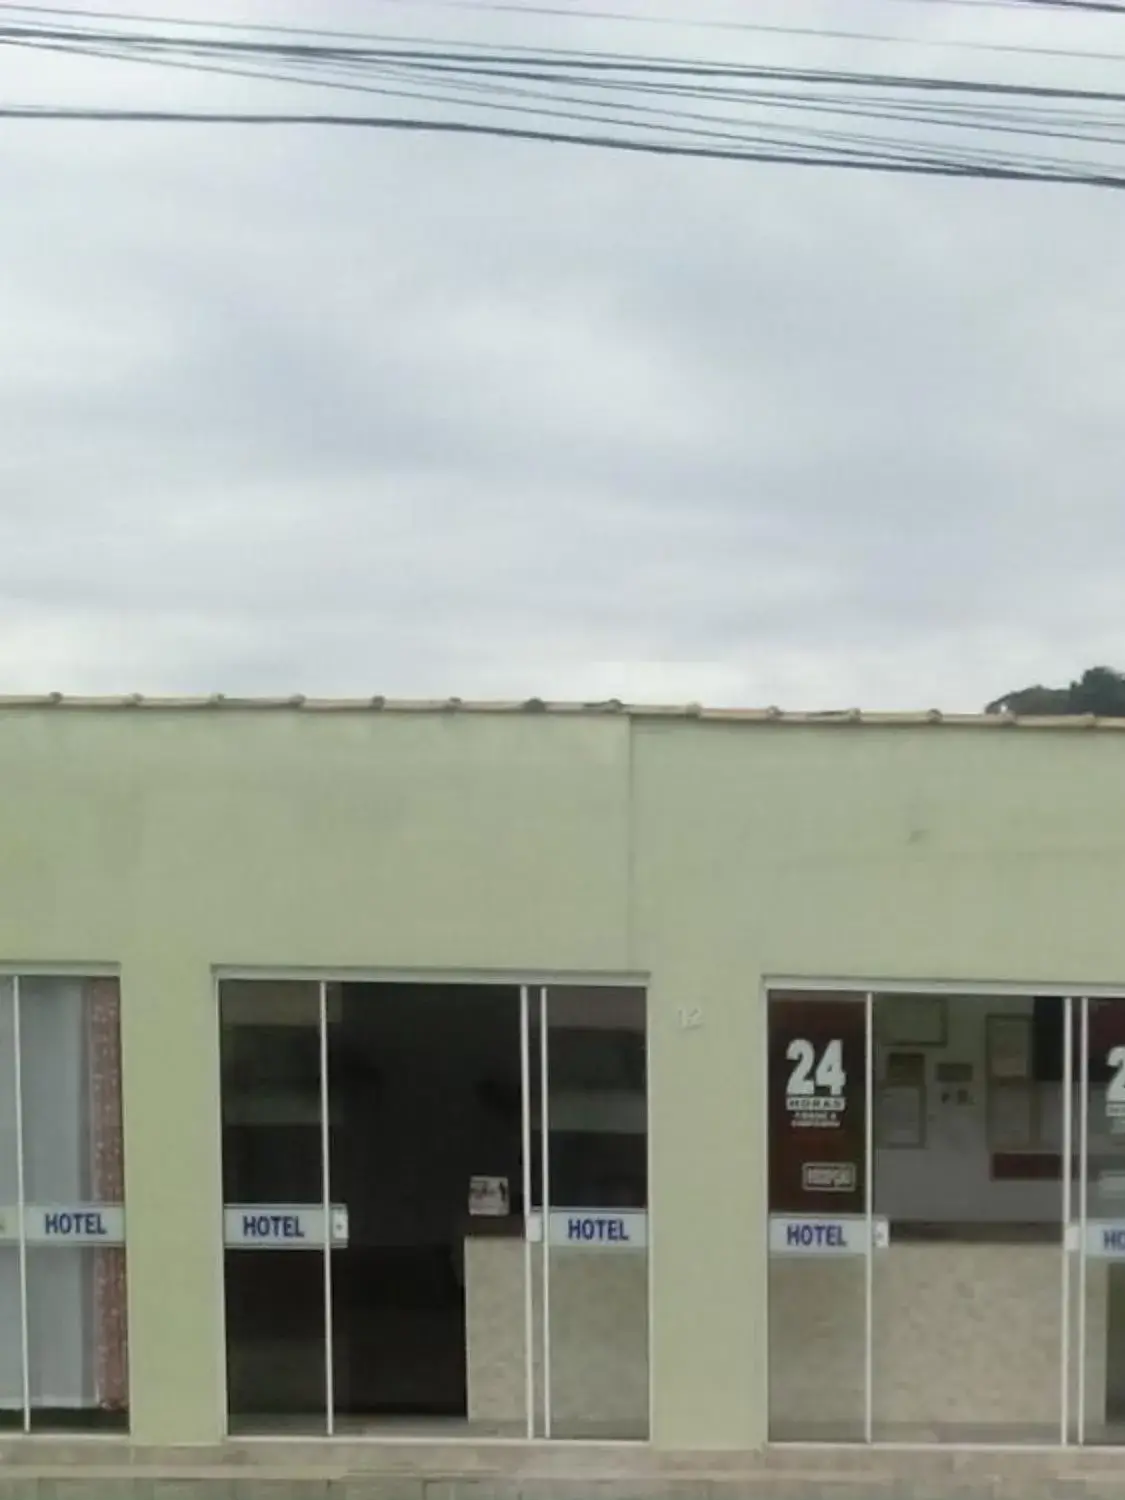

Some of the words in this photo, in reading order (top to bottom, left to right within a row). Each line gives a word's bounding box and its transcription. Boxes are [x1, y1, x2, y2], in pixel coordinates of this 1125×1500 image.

[786, 1038, 847, 1096] 24
[45, 1213, 107, 1235] HOTEL
[243, 1215, 305, 1238] HOTEL
[567, 1218, 629, 1241] HOTEL
[787, 1224, 847, 1246] HOTEL
